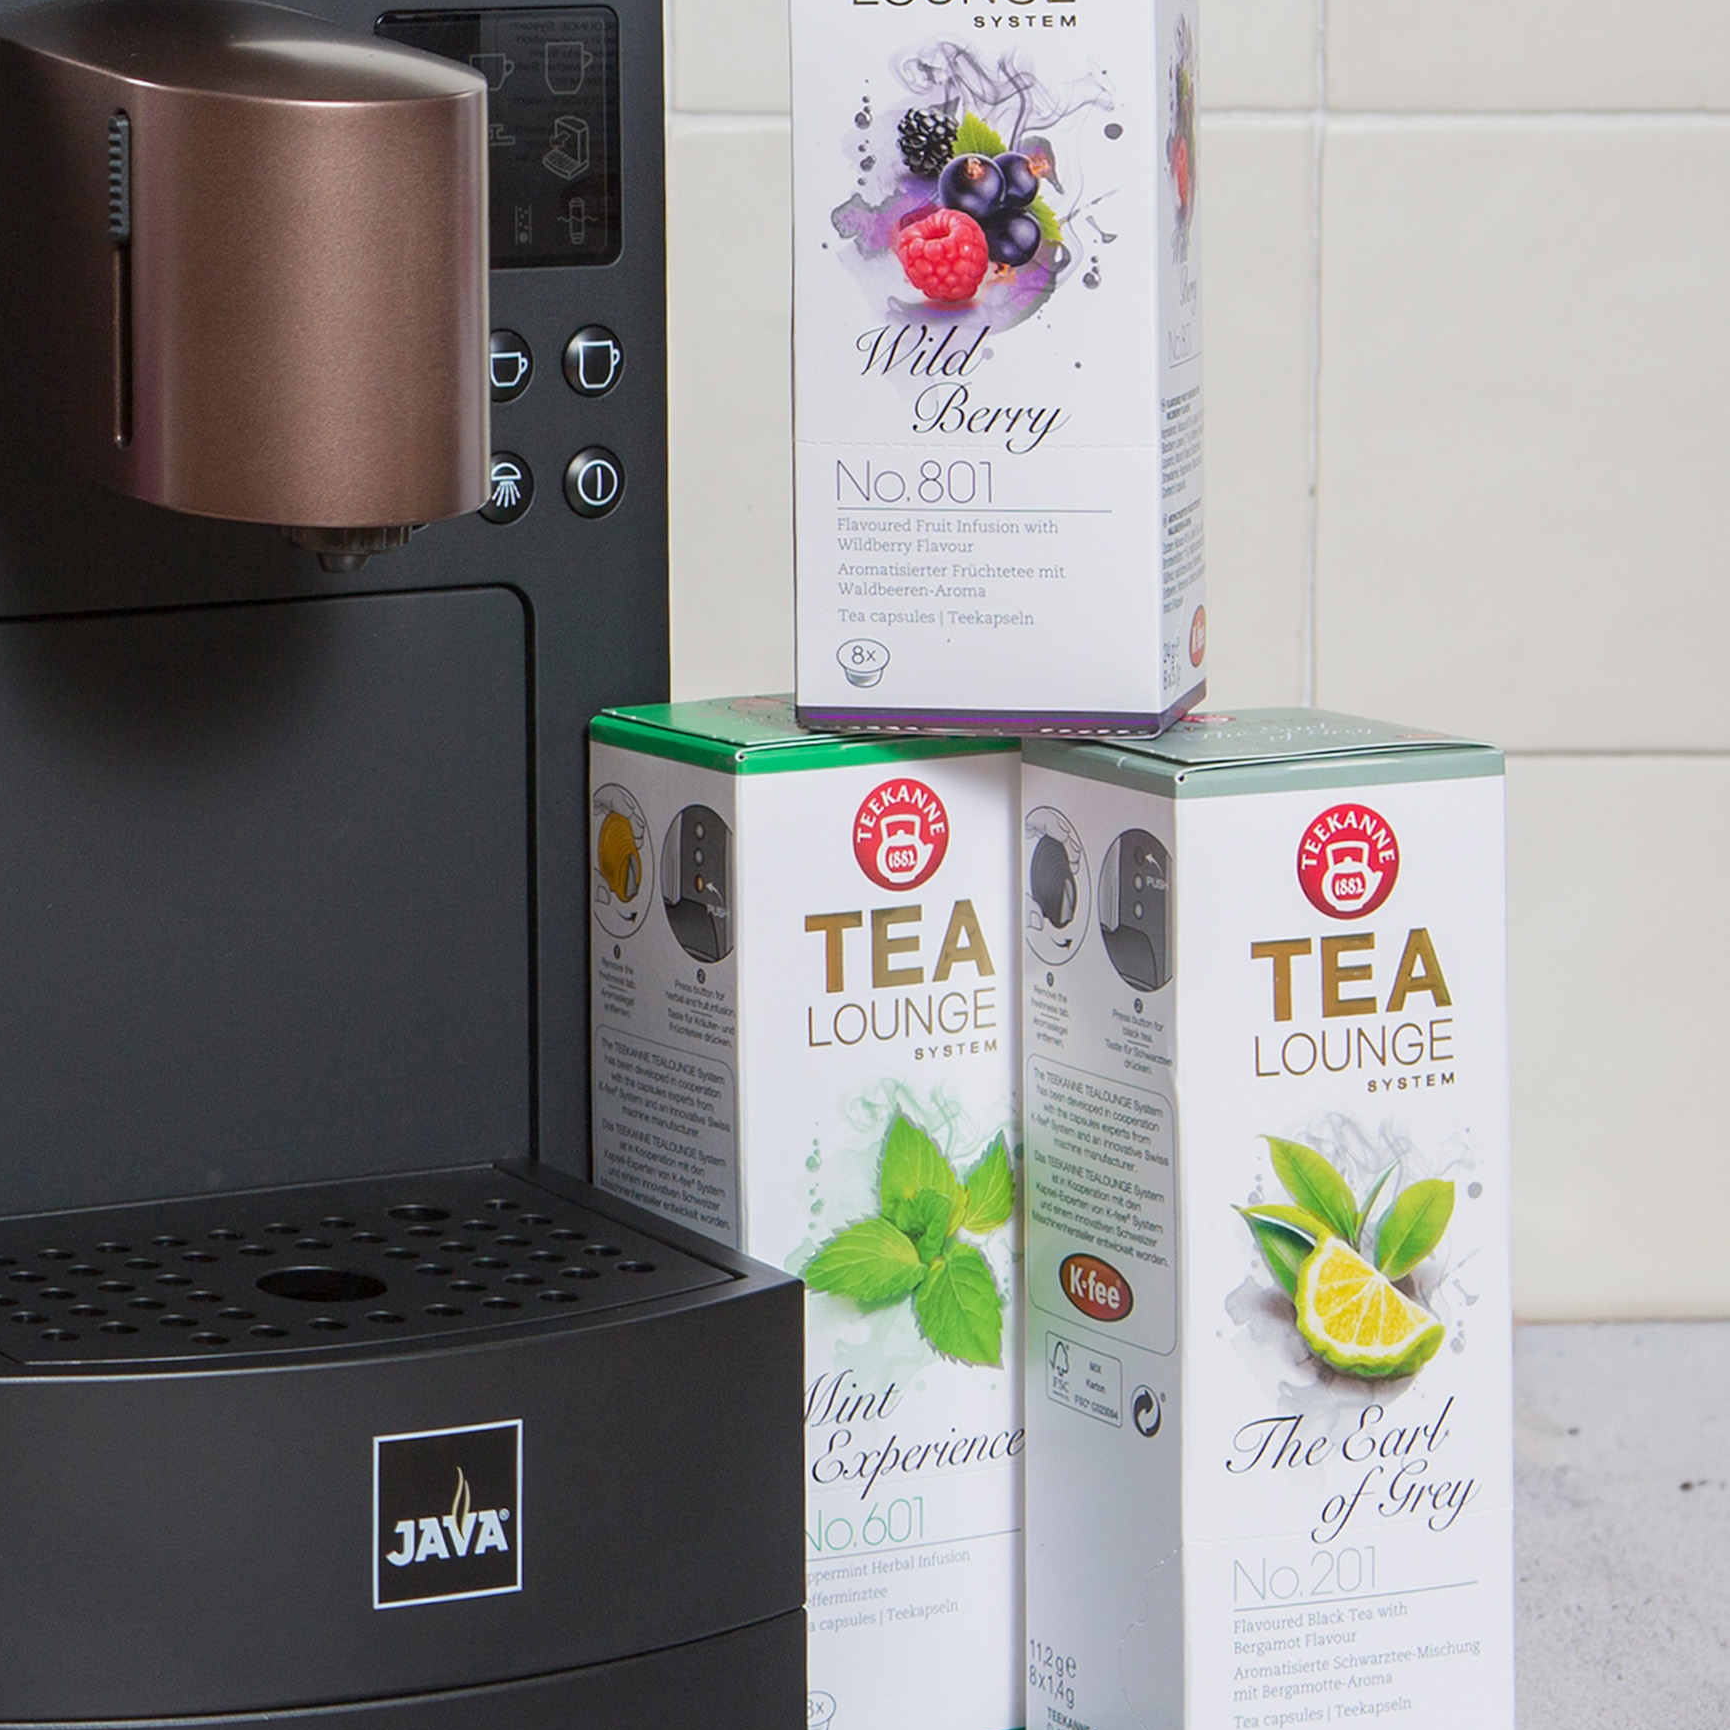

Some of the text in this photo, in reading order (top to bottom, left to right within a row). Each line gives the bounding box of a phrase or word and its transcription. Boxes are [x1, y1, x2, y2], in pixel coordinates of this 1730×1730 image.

[974, 15, 1076, 28] SYSTEM
[857, 324, 991, 376] Wild
[913, 383, 1061, 453] Berry
[838, 517, 1058, 533] Flavoured Fruit Infusion with
[837, 537, 974, 556] Wildberry Flavour
[838, 563, 1065, 578] Aromatisierter Früchtetee mit
[838, 582, 986, 597] Waldbeeren-Aroma
[838, 609, 1034, 628] Tea capsules Teekapseln
[852, 645, 876, 665] 8x
[857, 784, 945, 843] TEEKANNE
[1301, 809, 1396, 870] TEEKANNE
[888, 850, 917, 870] 1882
[1335, 875, 1364, 896] 1882
[805, 899, 995, 1000] TEA
[1251, 928, 1452, 1022] TEA
[808, 988, 996, 1050] LOUNGE
[915, 1039, 997, 1060] SYSTEM
[1255, 1018, 1453, 1077] LOUNGE
[1368, 1072, 1454, 1092] SYSTEM
[1226, 1396, 1454, 1472] The Earl
[812, 1426, 1026, 1501] Experience
[1311, 1460, 1474, 1543] of Grey
[386, 1509, 509, 1566] JAVA
[1234, 1602, 1407, 1634] Flavoured Black Tea with
[1234, 1632, 1357, 1657] Bergamot Flavour
[1234, 1641, 1480, 1680] Aromatisierte Schwarztee-Mischung
[1234, 1673, 1392, 1701] mit Bergamotte-Aroma
[1233, 1696, 1411, 1729] Tea capsules Teekapseln
